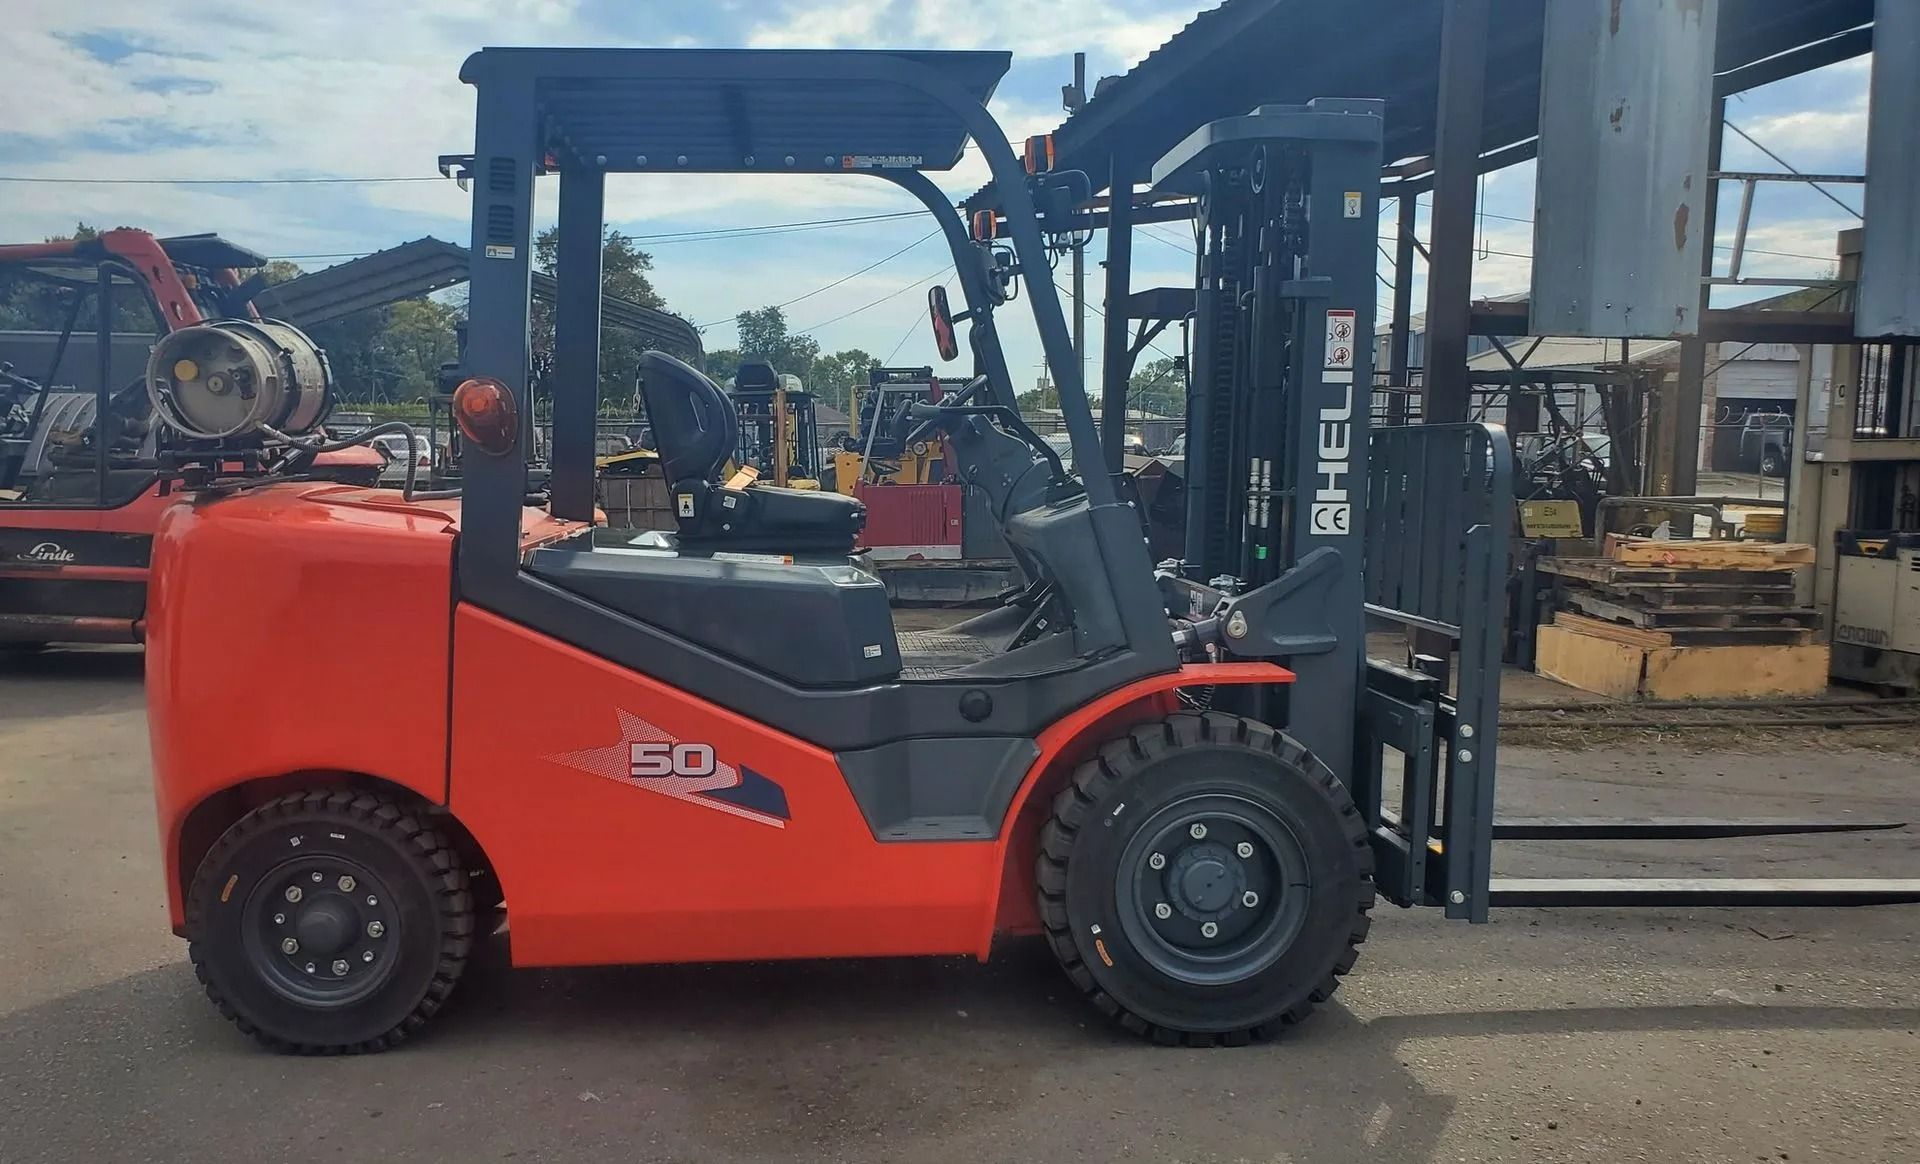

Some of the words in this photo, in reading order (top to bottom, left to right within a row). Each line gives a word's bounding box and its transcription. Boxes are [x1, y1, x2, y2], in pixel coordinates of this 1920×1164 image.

[1316, 371, 1353, 501] HELI
[1314, 507, 1347, 531] CE
[16, 542, 75, 562] Linde
[630, 742, 716, 778] 50
